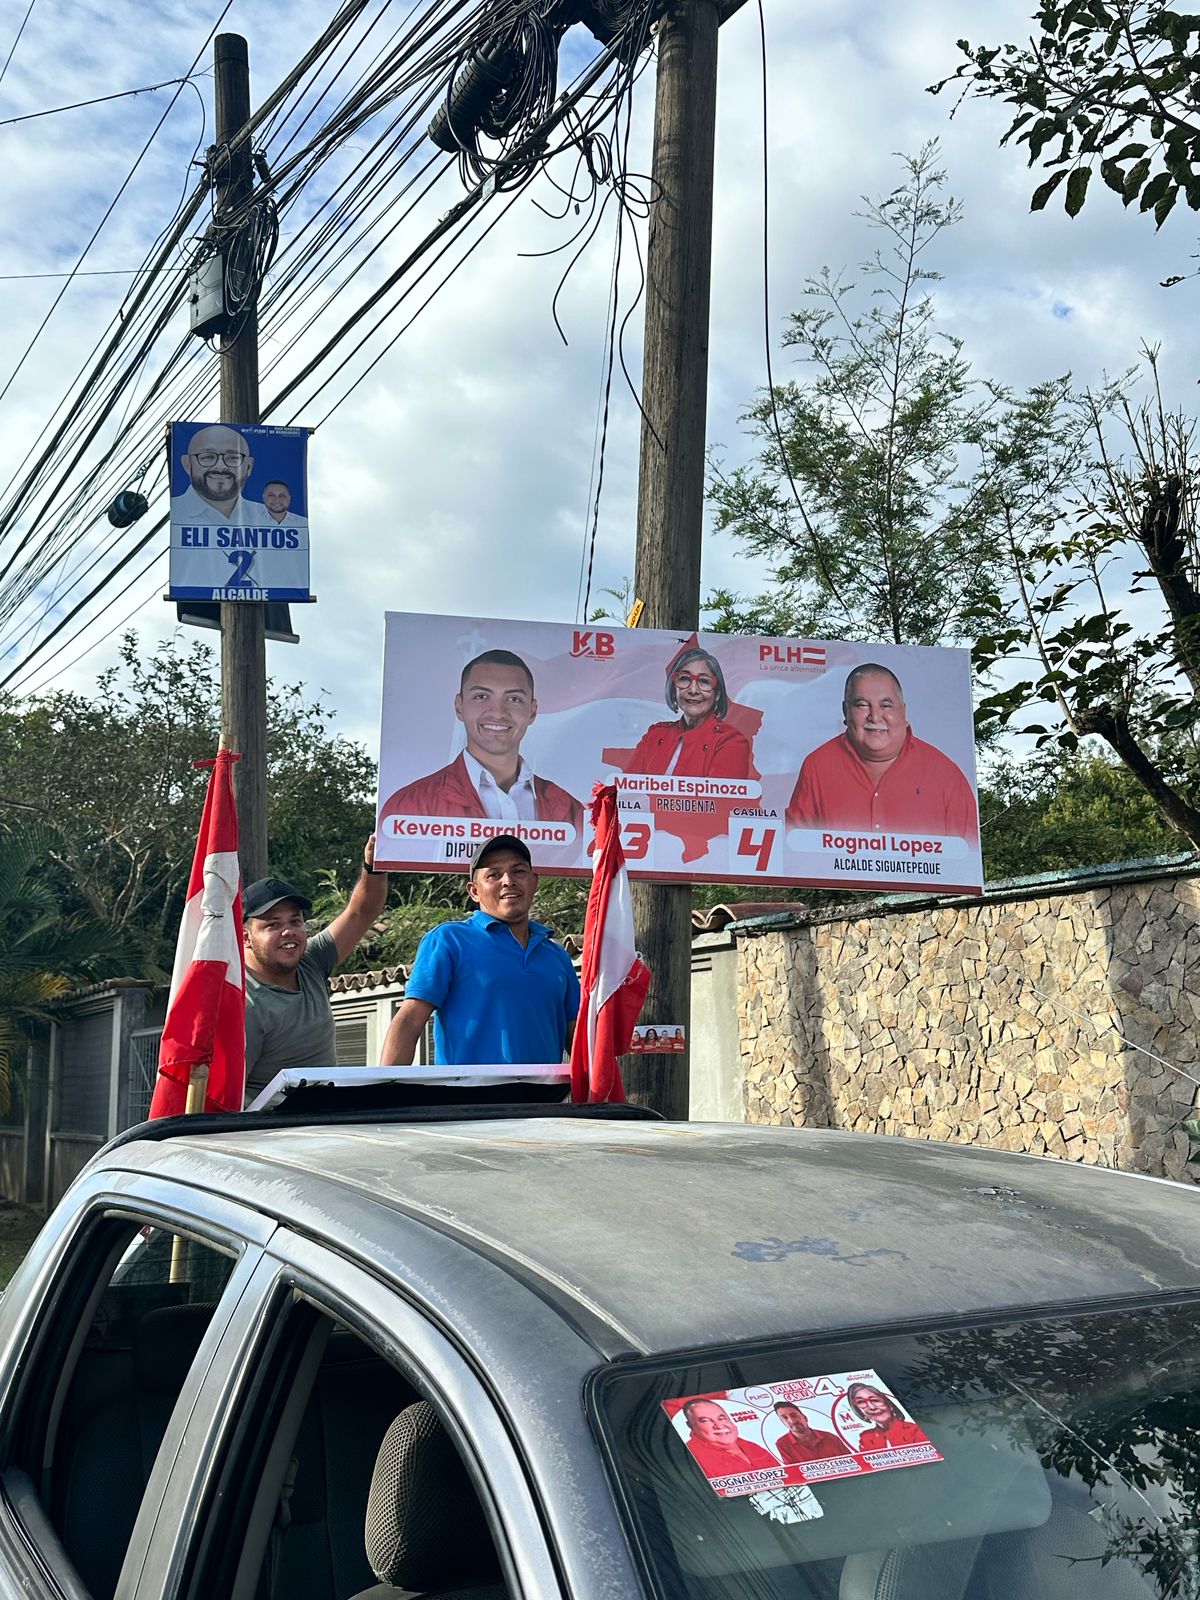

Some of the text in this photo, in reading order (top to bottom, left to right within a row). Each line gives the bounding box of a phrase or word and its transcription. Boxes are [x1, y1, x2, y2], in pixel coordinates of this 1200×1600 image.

[181, 527, 299, 549] ELI SANTOS
[228, 550, 253, 587] 2
[211, 588, 269, 601] ALCALDE
[572, 631, 615, 656] KB
[759, 645, 801, 663] PLH
[790, 665, 826, 673] alternativa
[614, 776, 747, 796] Maribel Espinoza
[618, 800, 641, 810] ILLA
[656, 798, 716, 813] PRESIDENTA
[733, 807, 777, 818] CASILLA
[393, 819, 566, 842] Kevens Barahona
[737, 828, 777, 872] 4
[822, 833, 942, 857] Rognal Lopez
[834, 858, 941, 875] ALCALDE SIGUATEPEQUE
[770, 1380, 812, 1394] VOTA EN LA
[814, 1377, 843, 1396] 4
[784, 1389, 815, 1402] CASILLA
[865, 1445, 934, 1462] MARIBEL ESPINOZA
[800, 1458, 856, 1472] CARLOS CERNA
[712, 1469, 786, 1489] ROGNAL LÓPEZ
